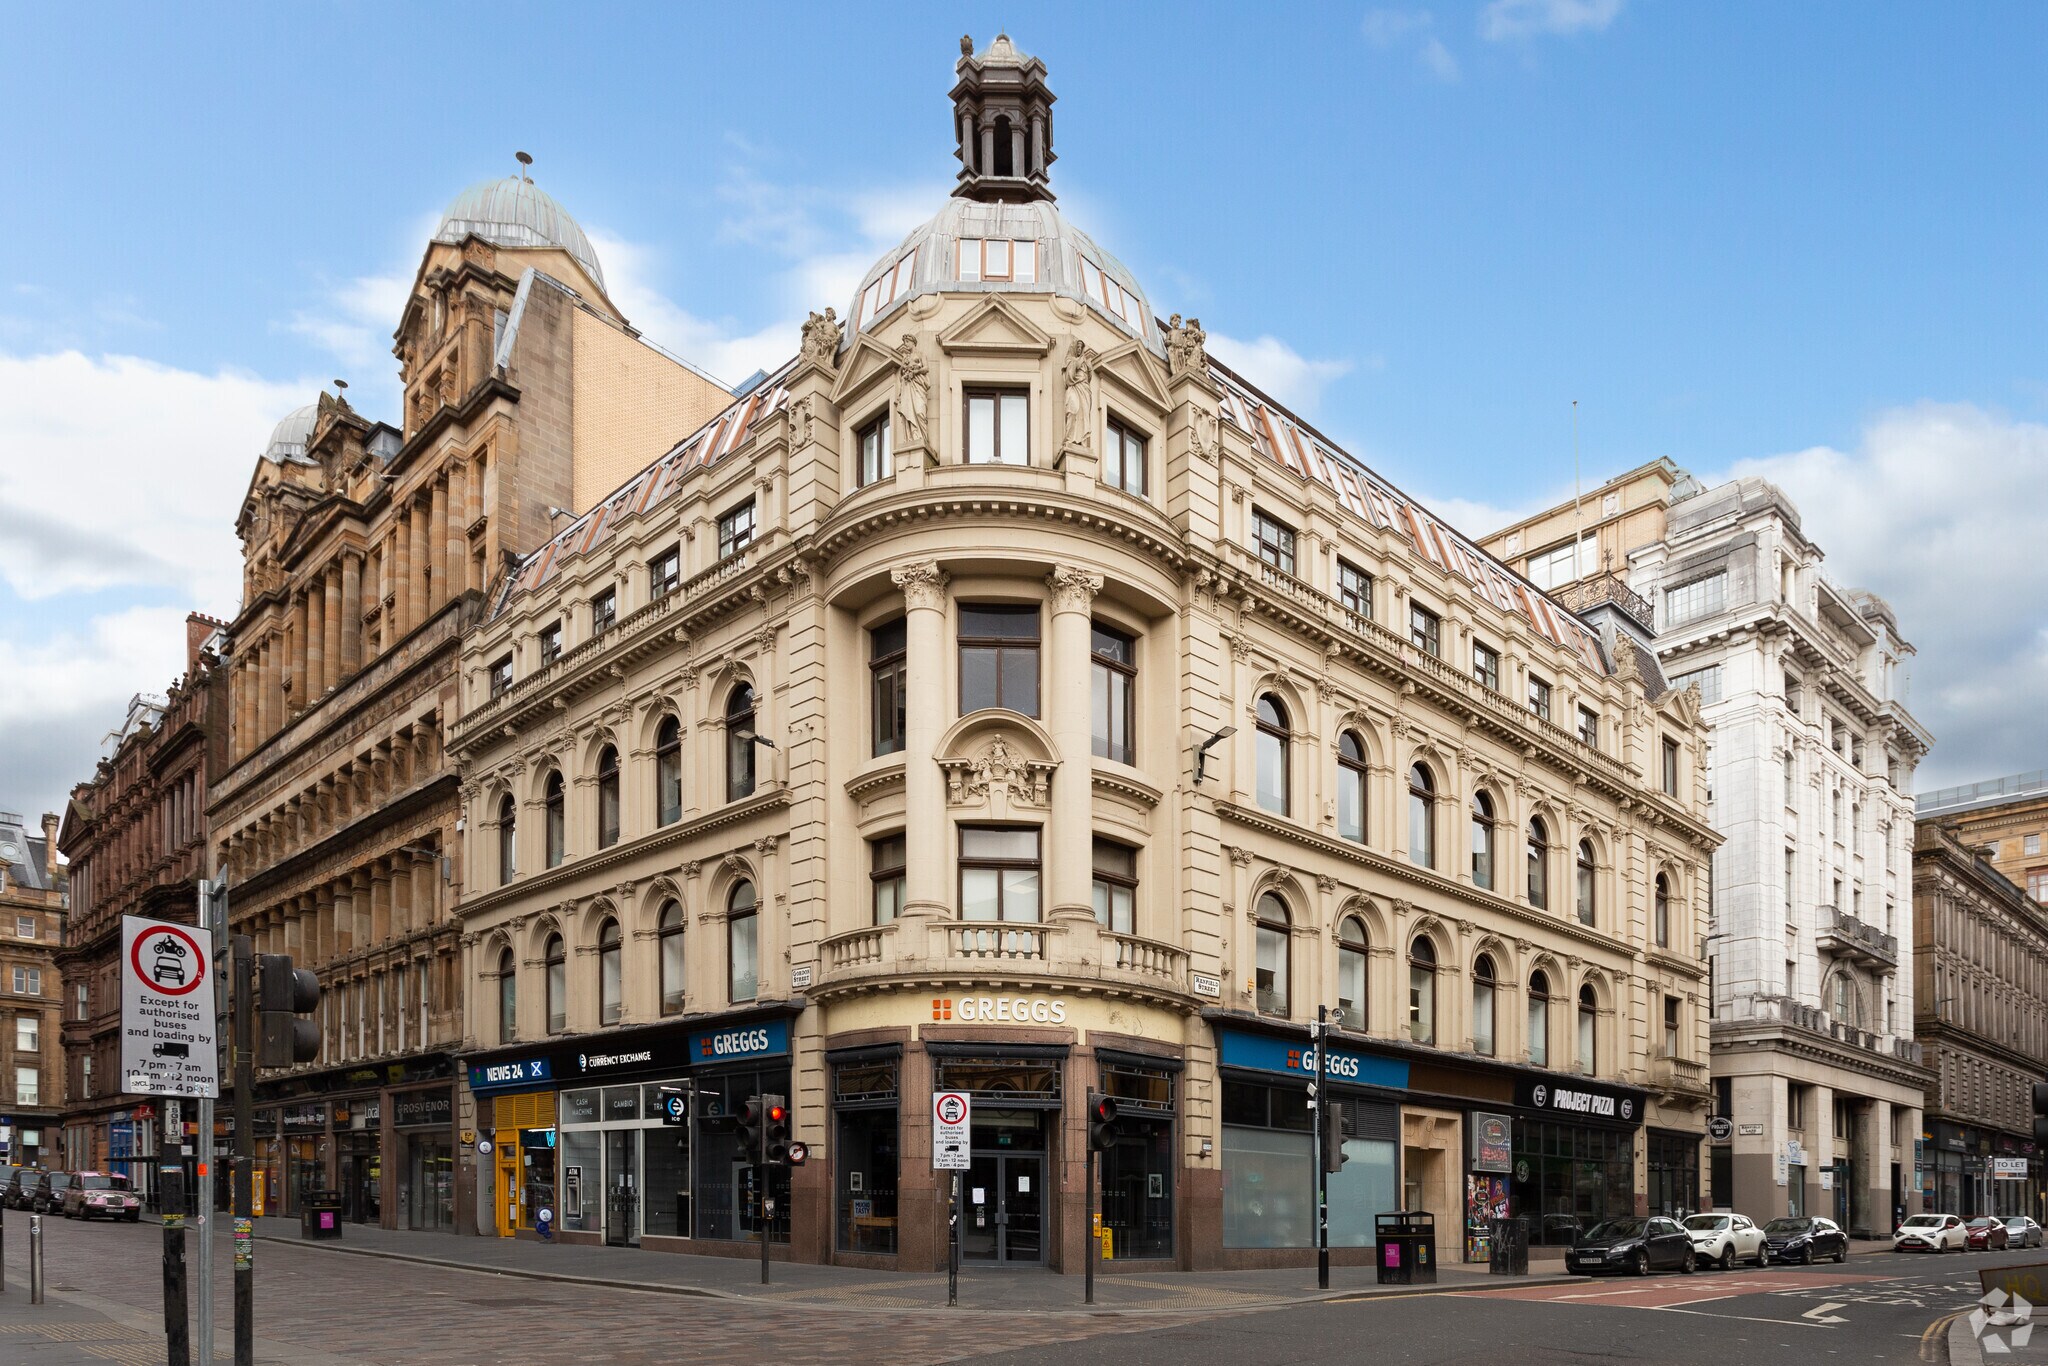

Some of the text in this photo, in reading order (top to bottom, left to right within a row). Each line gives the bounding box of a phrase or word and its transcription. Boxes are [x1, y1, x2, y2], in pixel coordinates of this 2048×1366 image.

[1198, 984, 1216, 992] STREET
[140, 995, 199, 1010] Except for
[140, 1008, 200, 1020] authorised
[958, 997, 1066, 1023] GREGGS
[154, 1019, 187, 1030] buses
[128, 1029, 211, 1044] and loading by
[714, 1029, 768, 1054] GREGGS
[139, 1059, 146, 1068] 7
[176, 1062, 182, 1070] 7
[589, 1051, 651, 1067] CURRENCY EXCHANGE
[187, 1075, 214, 1083] noon
[486, 1064, 523, 1081] NEWS 24
[398, 1099, 449, 1113] GROSVENOR
[614, 1100, 633, 1108] CAMBIO
[1554, 1089, 1614, 1116] PROJECT PIZZA
[365, 1104, 379, 1119] Local
[572, 1108, 592, 1116] MACHINE
